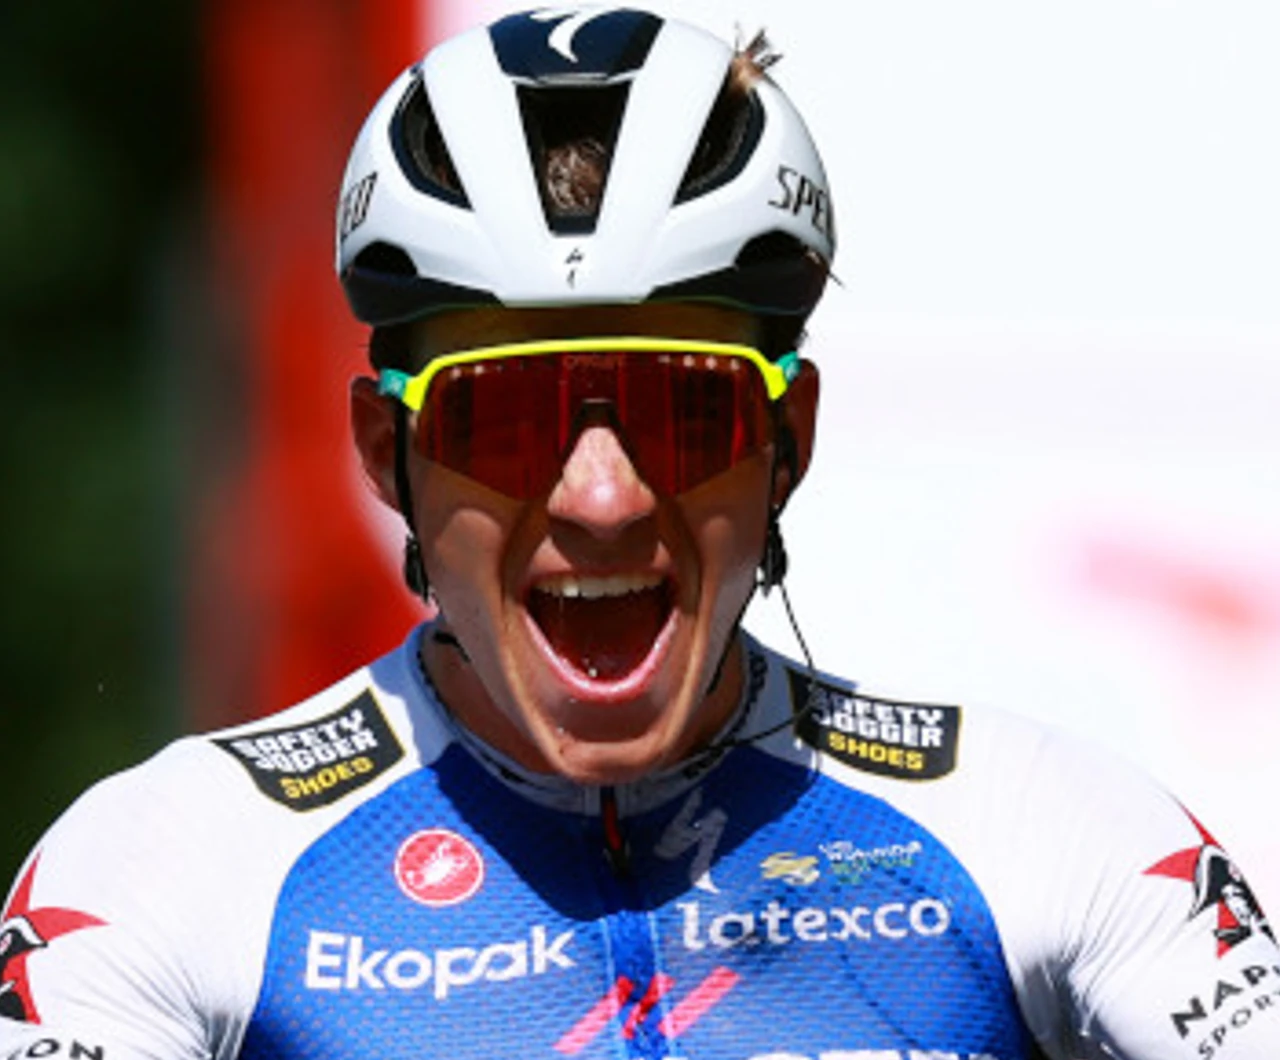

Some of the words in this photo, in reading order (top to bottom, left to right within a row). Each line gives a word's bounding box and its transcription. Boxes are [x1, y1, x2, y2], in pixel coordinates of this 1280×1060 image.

[230, 709, 365, 758] SAFETY
[255, 728, 378, 773] JOGGER
[829, 731, 926, 772] SHOES
[280, 756, 374, 799] SHOES
[675, 897, 951, 950] latexco
[304, 924, 578, 1001] Ekopak
